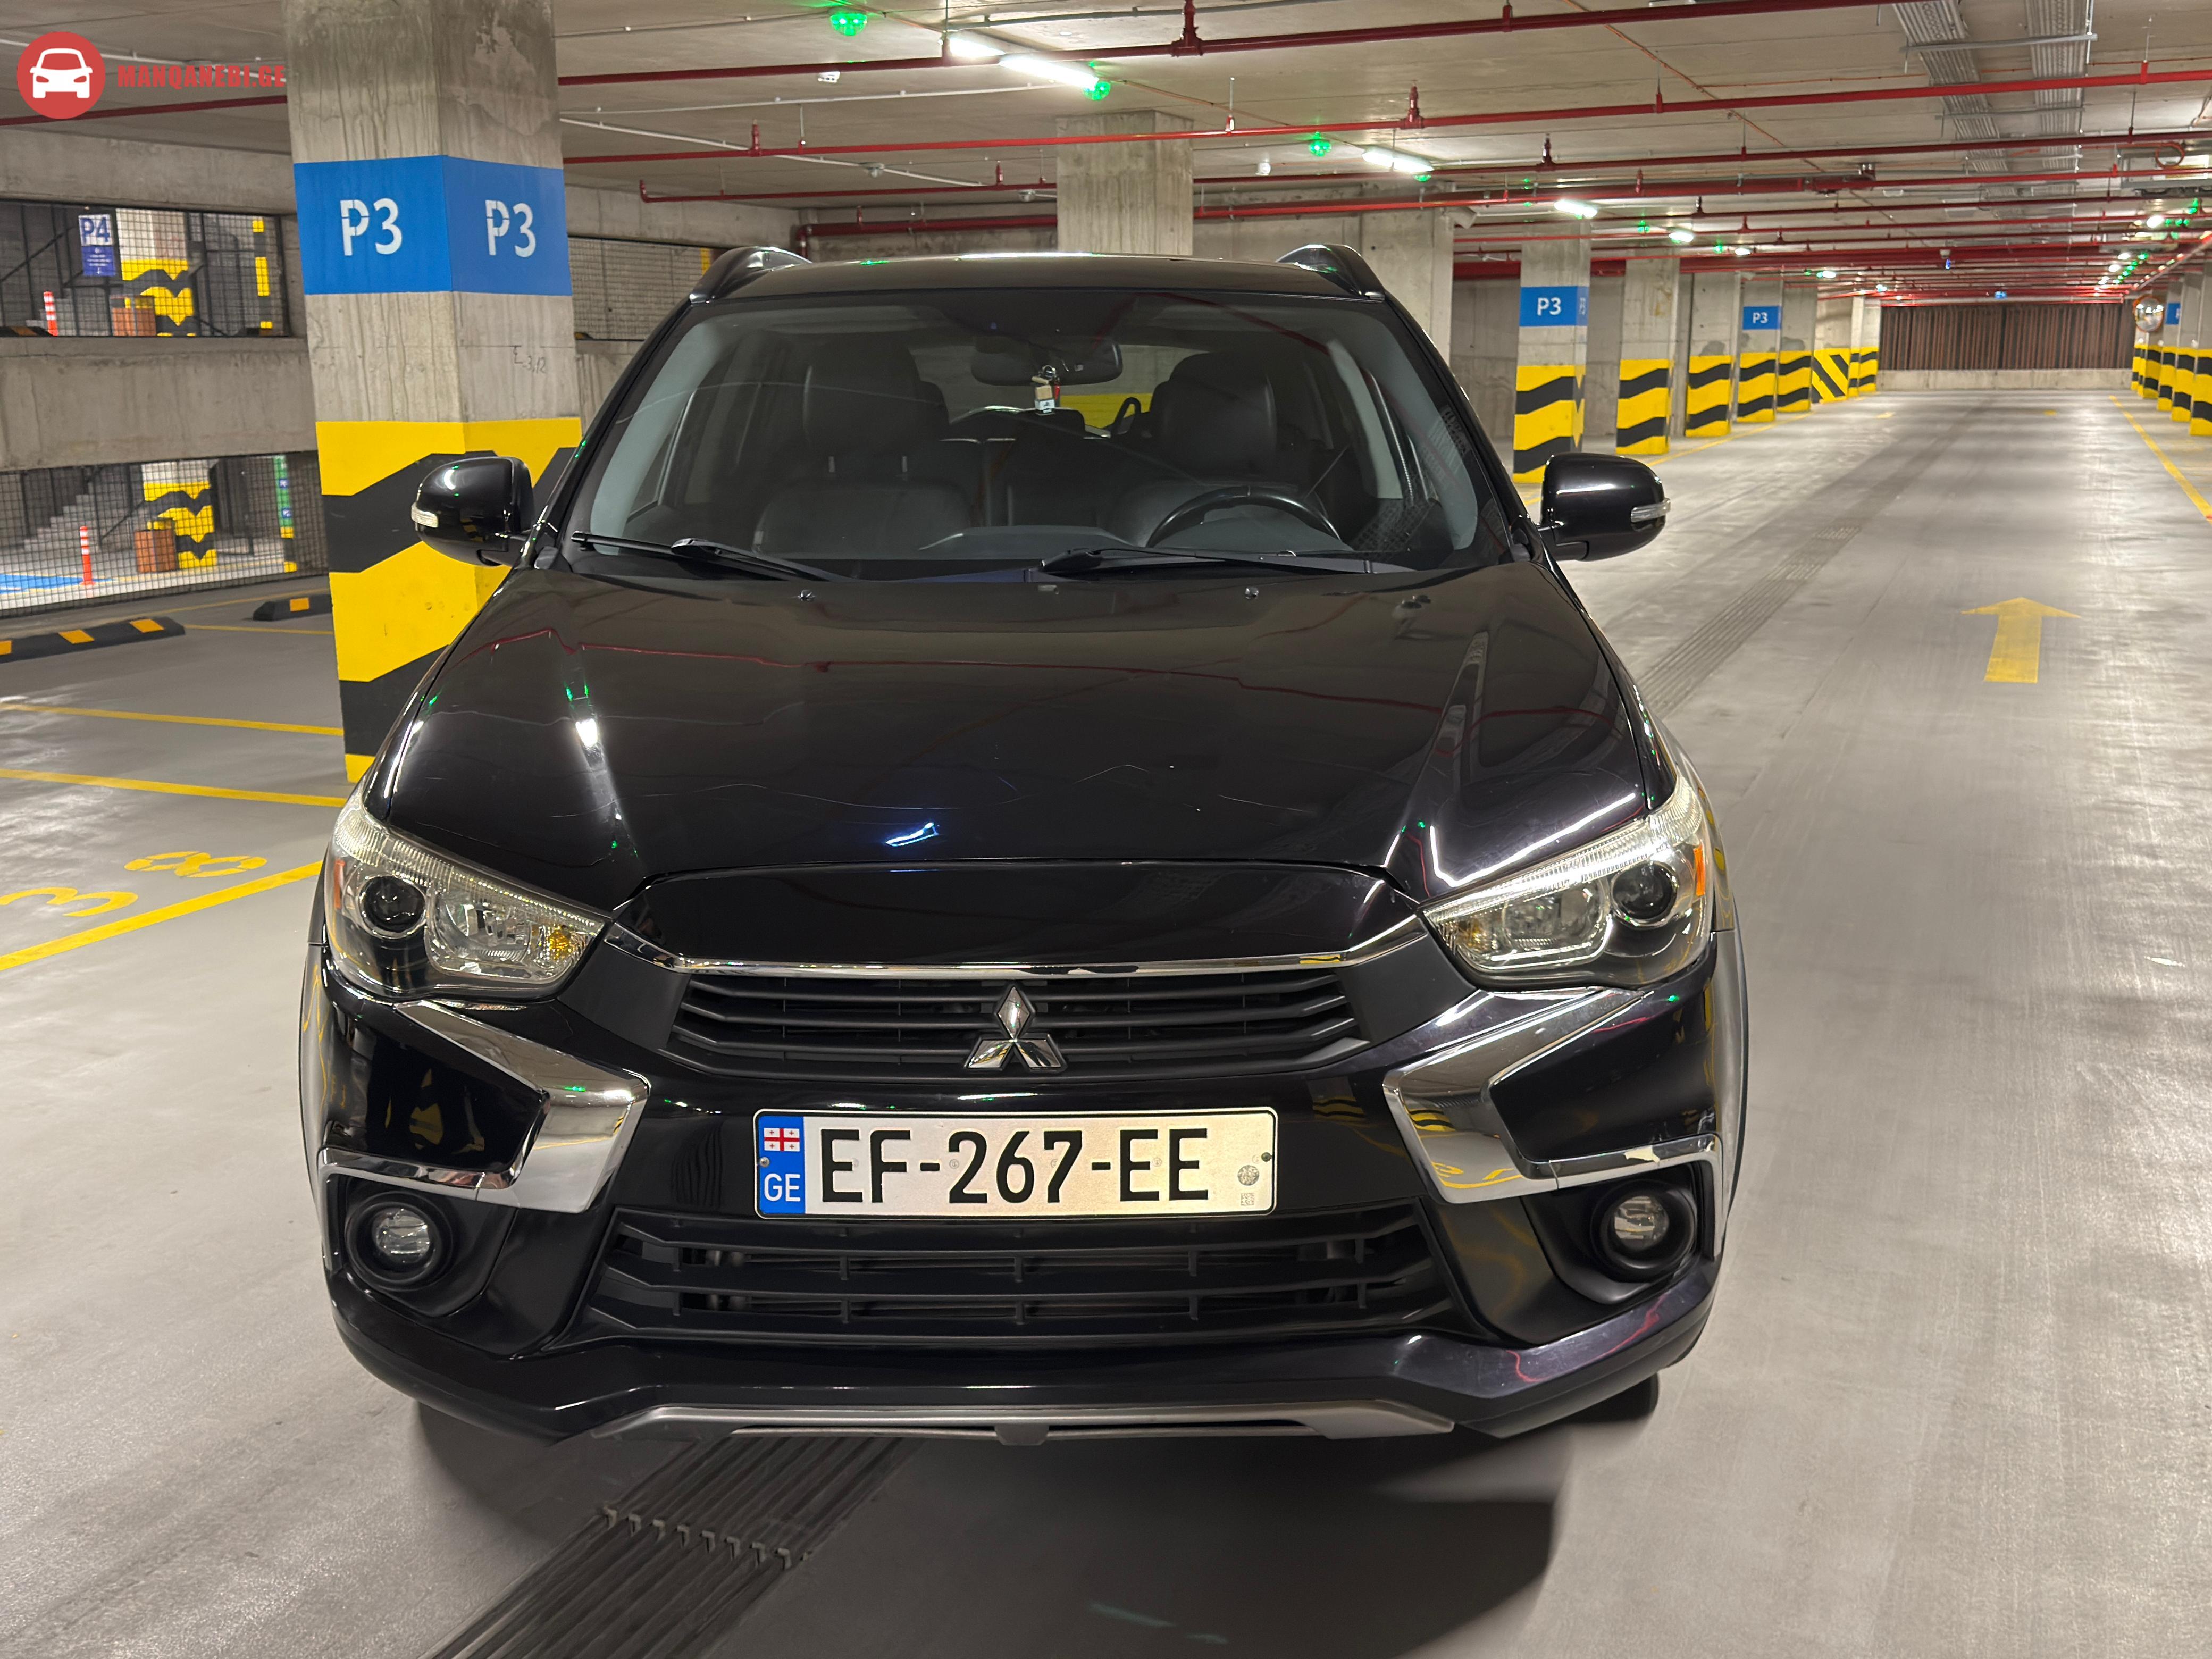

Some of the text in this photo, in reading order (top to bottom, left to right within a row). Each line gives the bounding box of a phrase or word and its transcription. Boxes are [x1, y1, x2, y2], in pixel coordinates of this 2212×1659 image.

[80, 217, 110, 243] P4
[340, 198, 403, 256] P3
[485, 199, 537, 258] P3
[1537, 297, 1562, 316] P3
[1752, 312, 1769, 324] P3
[820, 1128, 1209, 1204] EF-267-EE
[764, 1172, 801, 1202] GE
